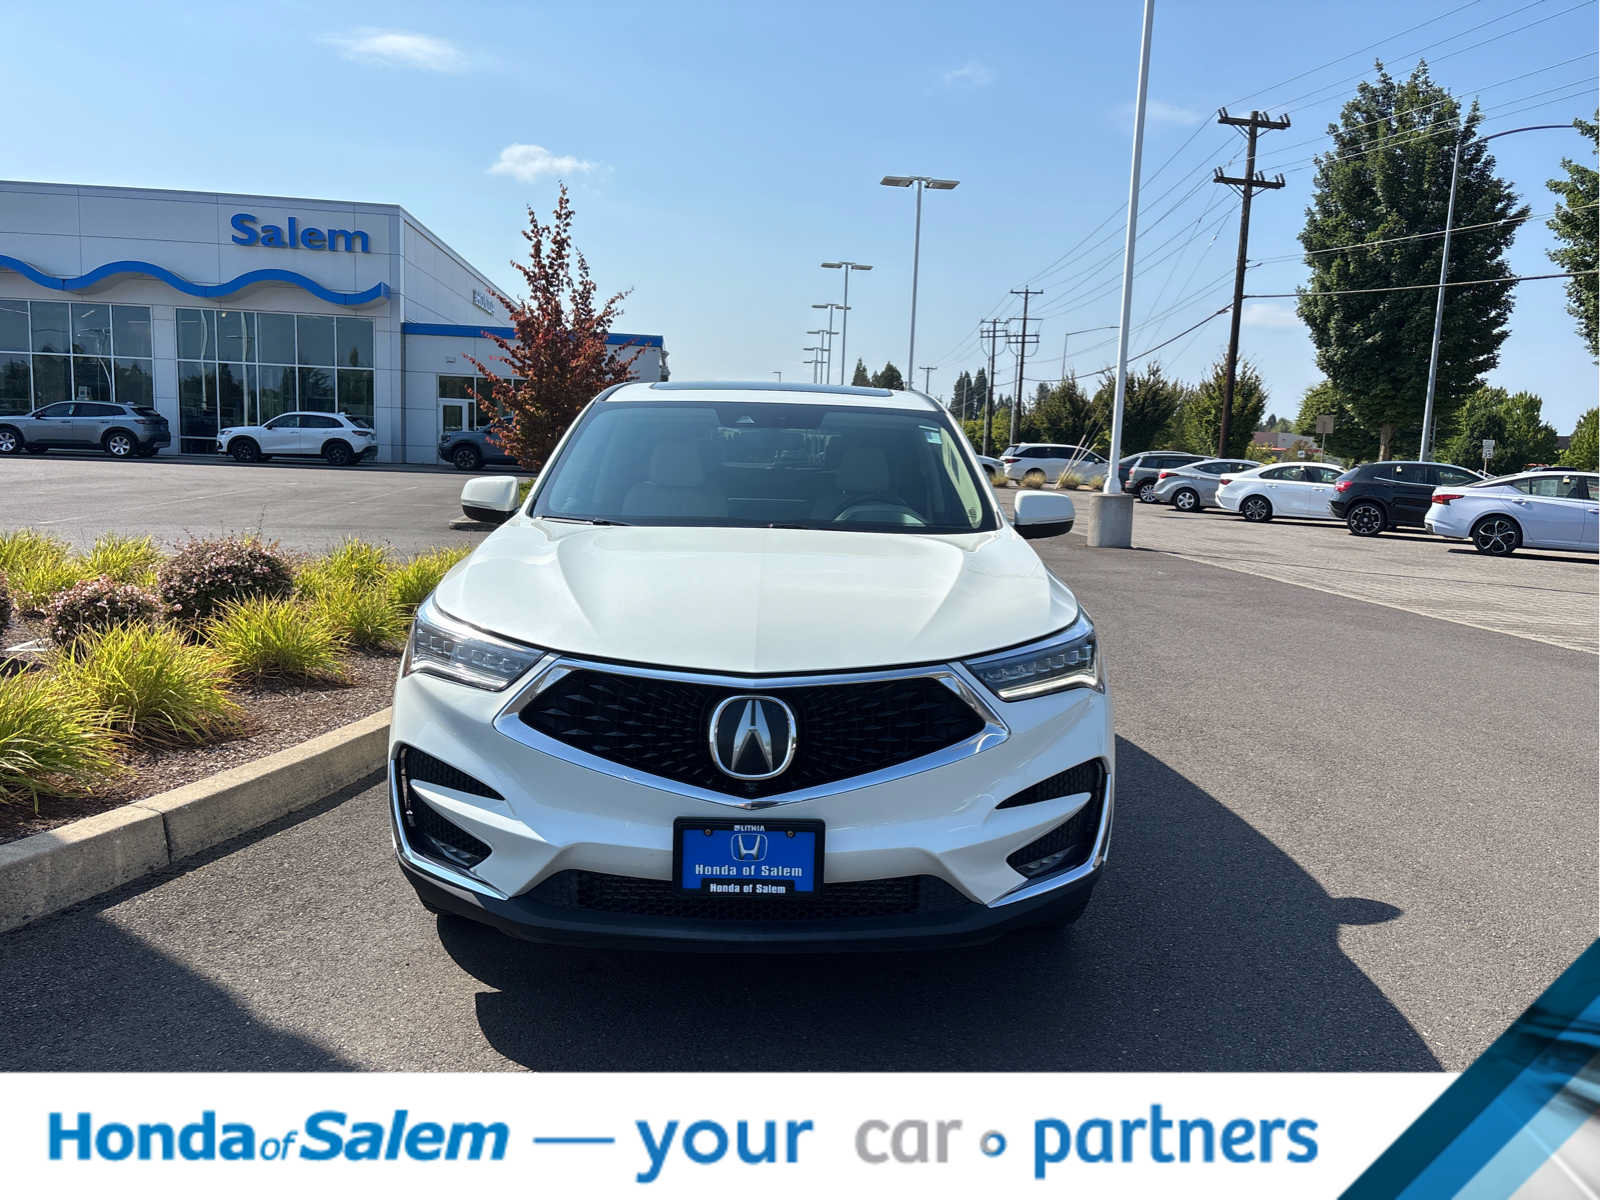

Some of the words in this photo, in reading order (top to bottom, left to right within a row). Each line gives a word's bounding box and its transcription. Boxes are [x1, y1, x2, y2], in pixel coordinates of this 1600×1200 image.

[230, 213, 370, 254] Salem
[695, 864, 737, 876] Honda
[742, 865, 755, 876] of
[761, 865, 803, 877] Salem
[709, 883, 740, 893] Honda
[743, 883, 753, 893] of
[756, 884, 786, 894] Salem
